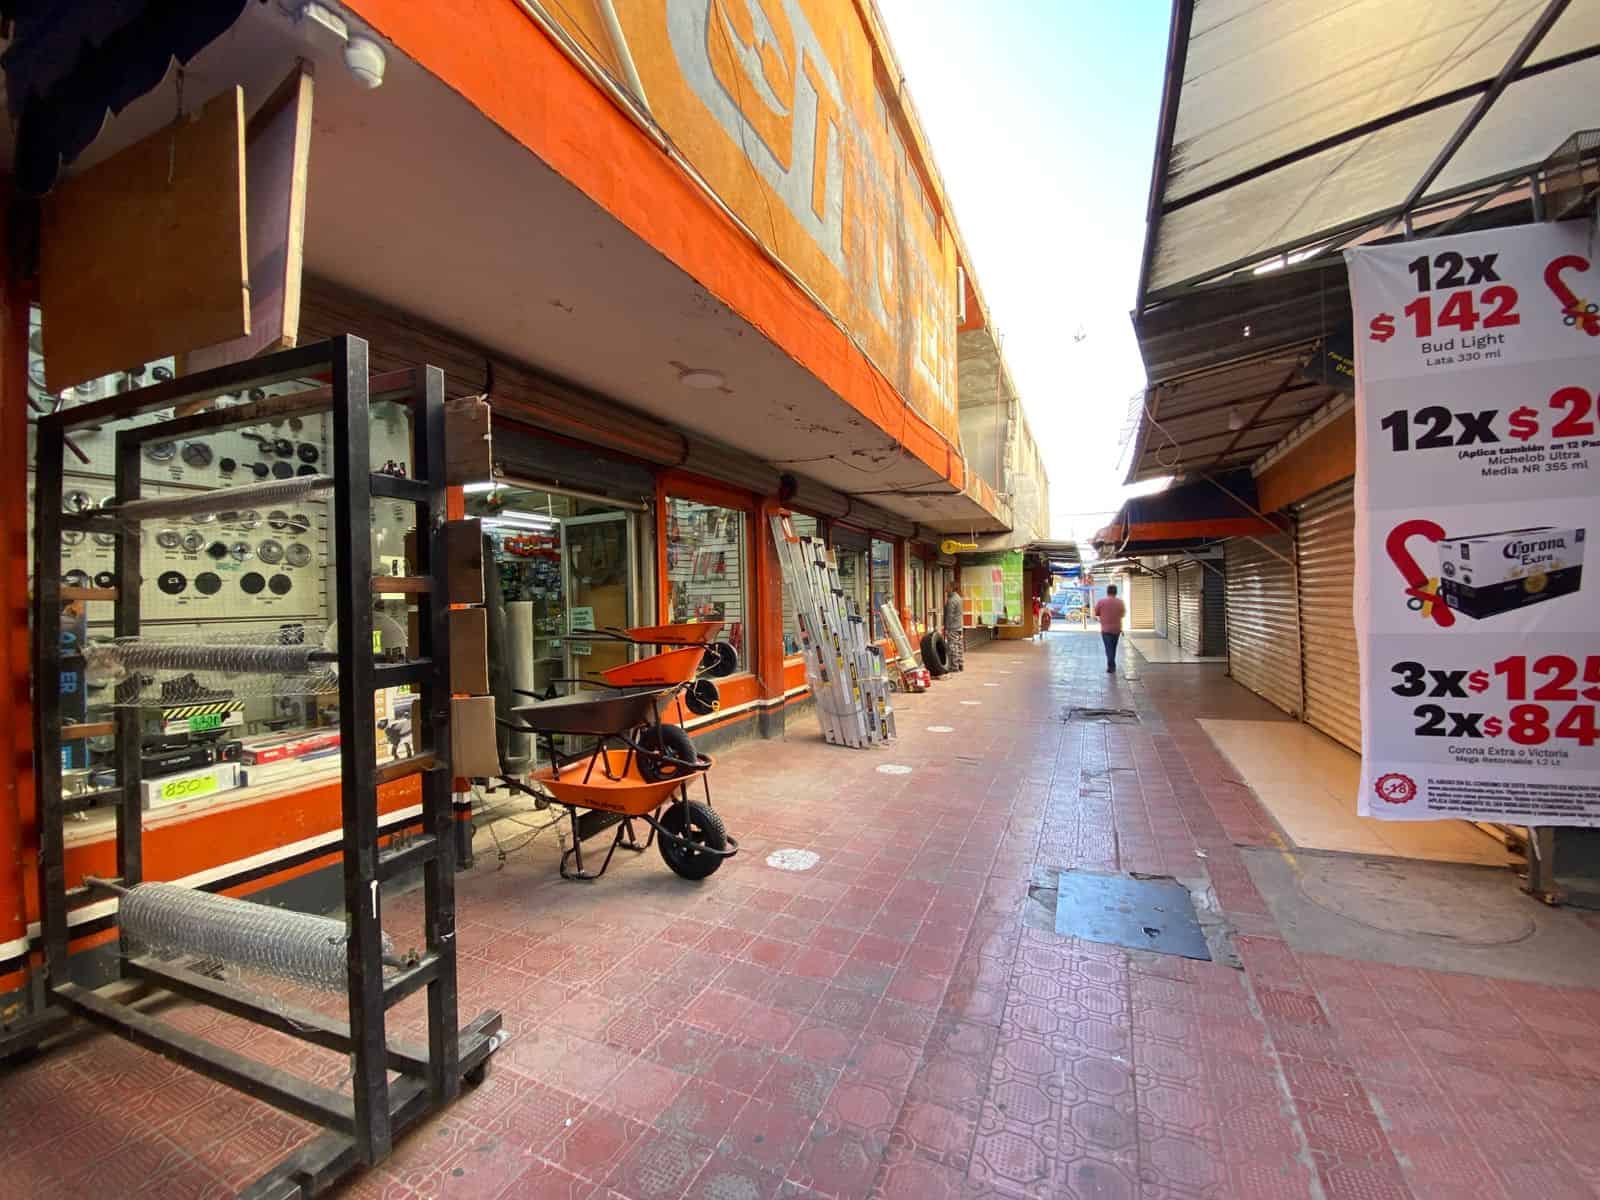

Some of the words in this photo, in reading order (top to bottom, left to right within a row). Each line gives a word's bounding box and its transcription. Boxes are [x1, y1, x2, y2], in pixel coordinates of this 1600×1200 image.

[1408, 252, 1501, 292] 12x
[1421, 338, 1454, 354] Bud
[1461, 332, 1505, 350] Light
[1426, 356, 1455, 366] Lata
[1507, 386, 1600, 442] $2
[1488, 454, 1545, 466] Michelob
[1549, 450, 1580, 460] Ultra
[1481, 467, 1519, 477] Media
[1522, 464, 1540, 473] NR
[1545, 462, 1568, 472] 355
[1571, 460, 1588, 470] ml
[1503, 537, 1567, 560] Corona
[1521, 553, 1553, 566] Extra
[1448, 745, 1485, 755] Corona
[1487, 747, 1515, 756] Extra
[1528, 748, 1569, 758] Victoria
